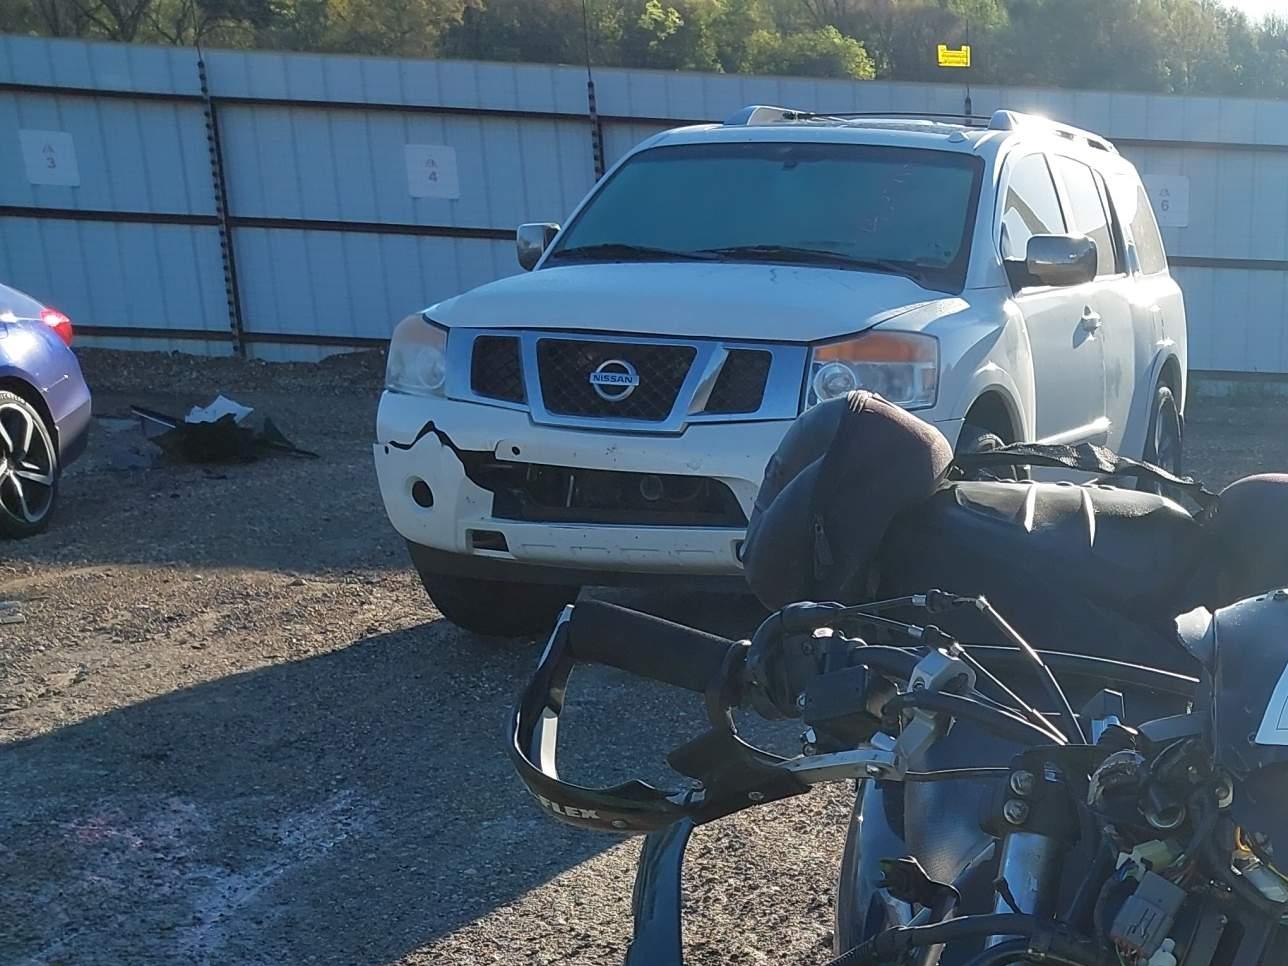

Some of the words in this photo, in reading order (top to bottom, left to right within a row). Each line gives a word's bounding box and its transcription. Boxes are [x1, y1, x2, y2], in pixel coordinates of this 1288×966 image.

[46, 157, 57, 169] 3
[428, 170, 438, 183] 4
[1160, 199, 1169, 212] 6
[592, 374, 633, 384] NISSAN
